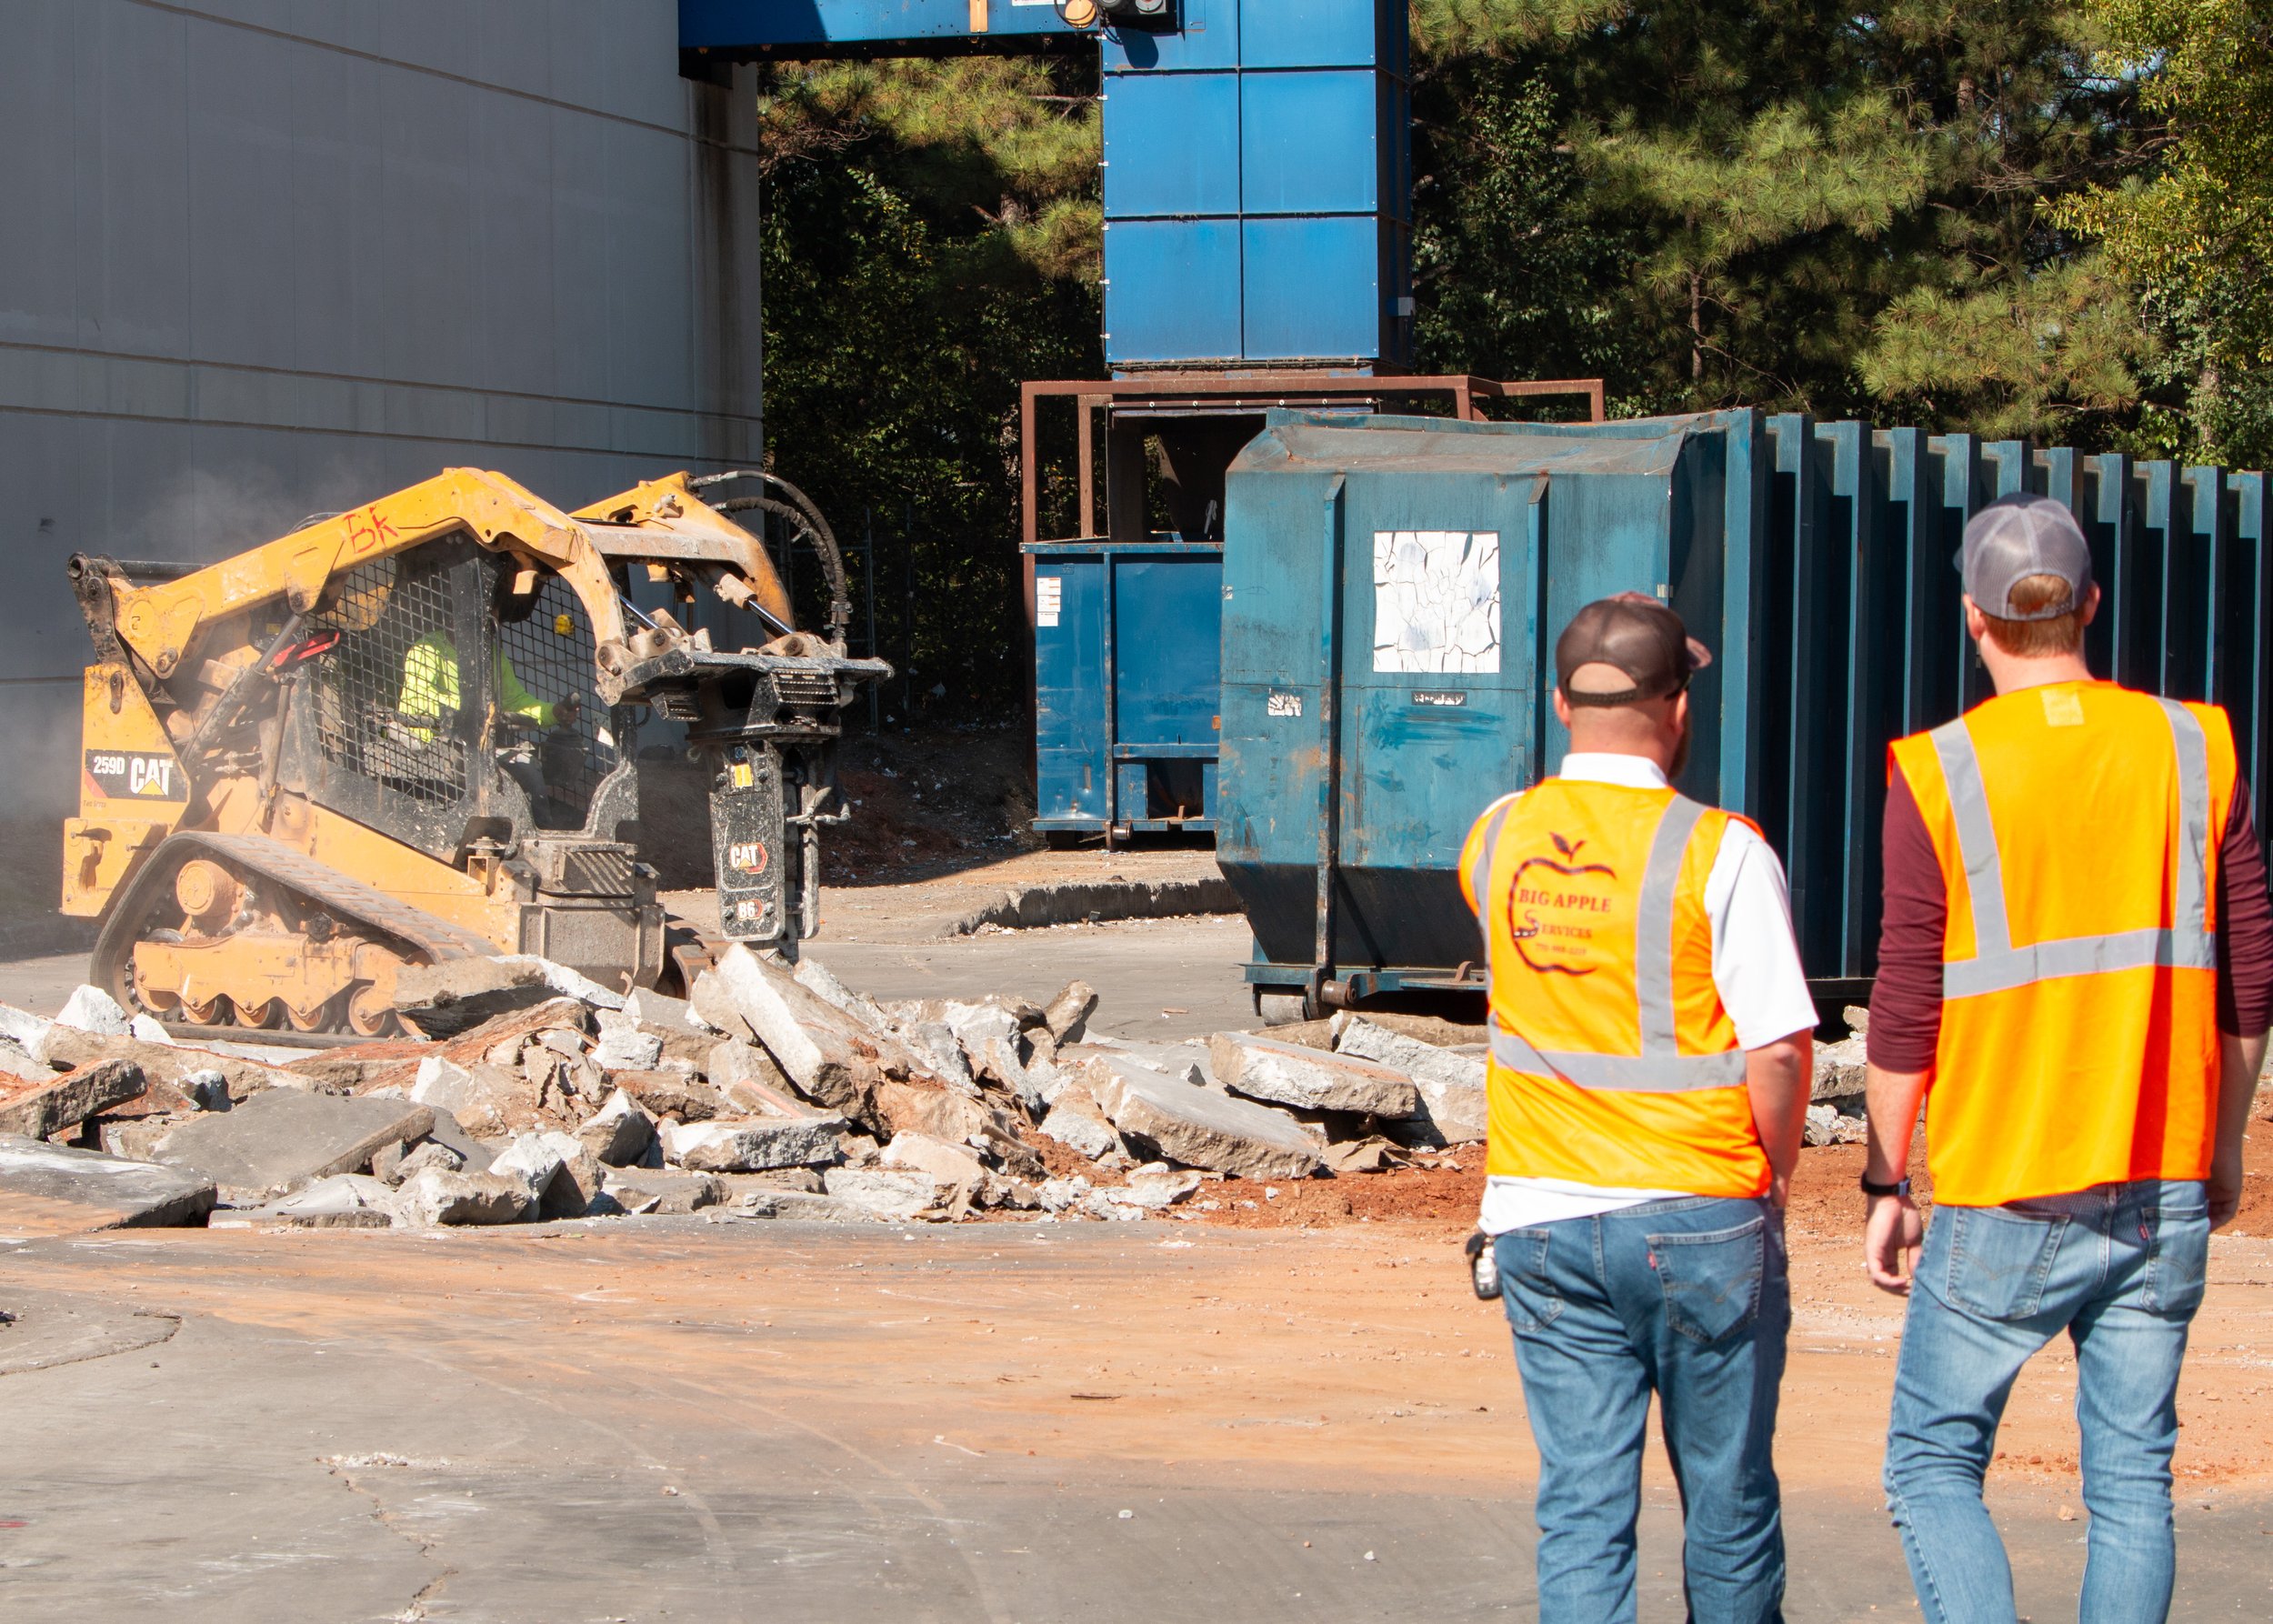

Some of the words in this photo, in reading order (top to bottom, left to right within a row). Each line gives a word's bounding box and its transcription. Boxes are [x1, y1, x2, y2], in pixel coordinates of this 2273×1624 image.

[93, 756, 125, 775] 259D
[130, 757, 174, 797] CAT
[730, 845, 758, 868] CAT
[738, 902, 756, 918] B6
[1518, 888, 1549, 906] BIG
[1553, 893, 1612, 913] APPLE
